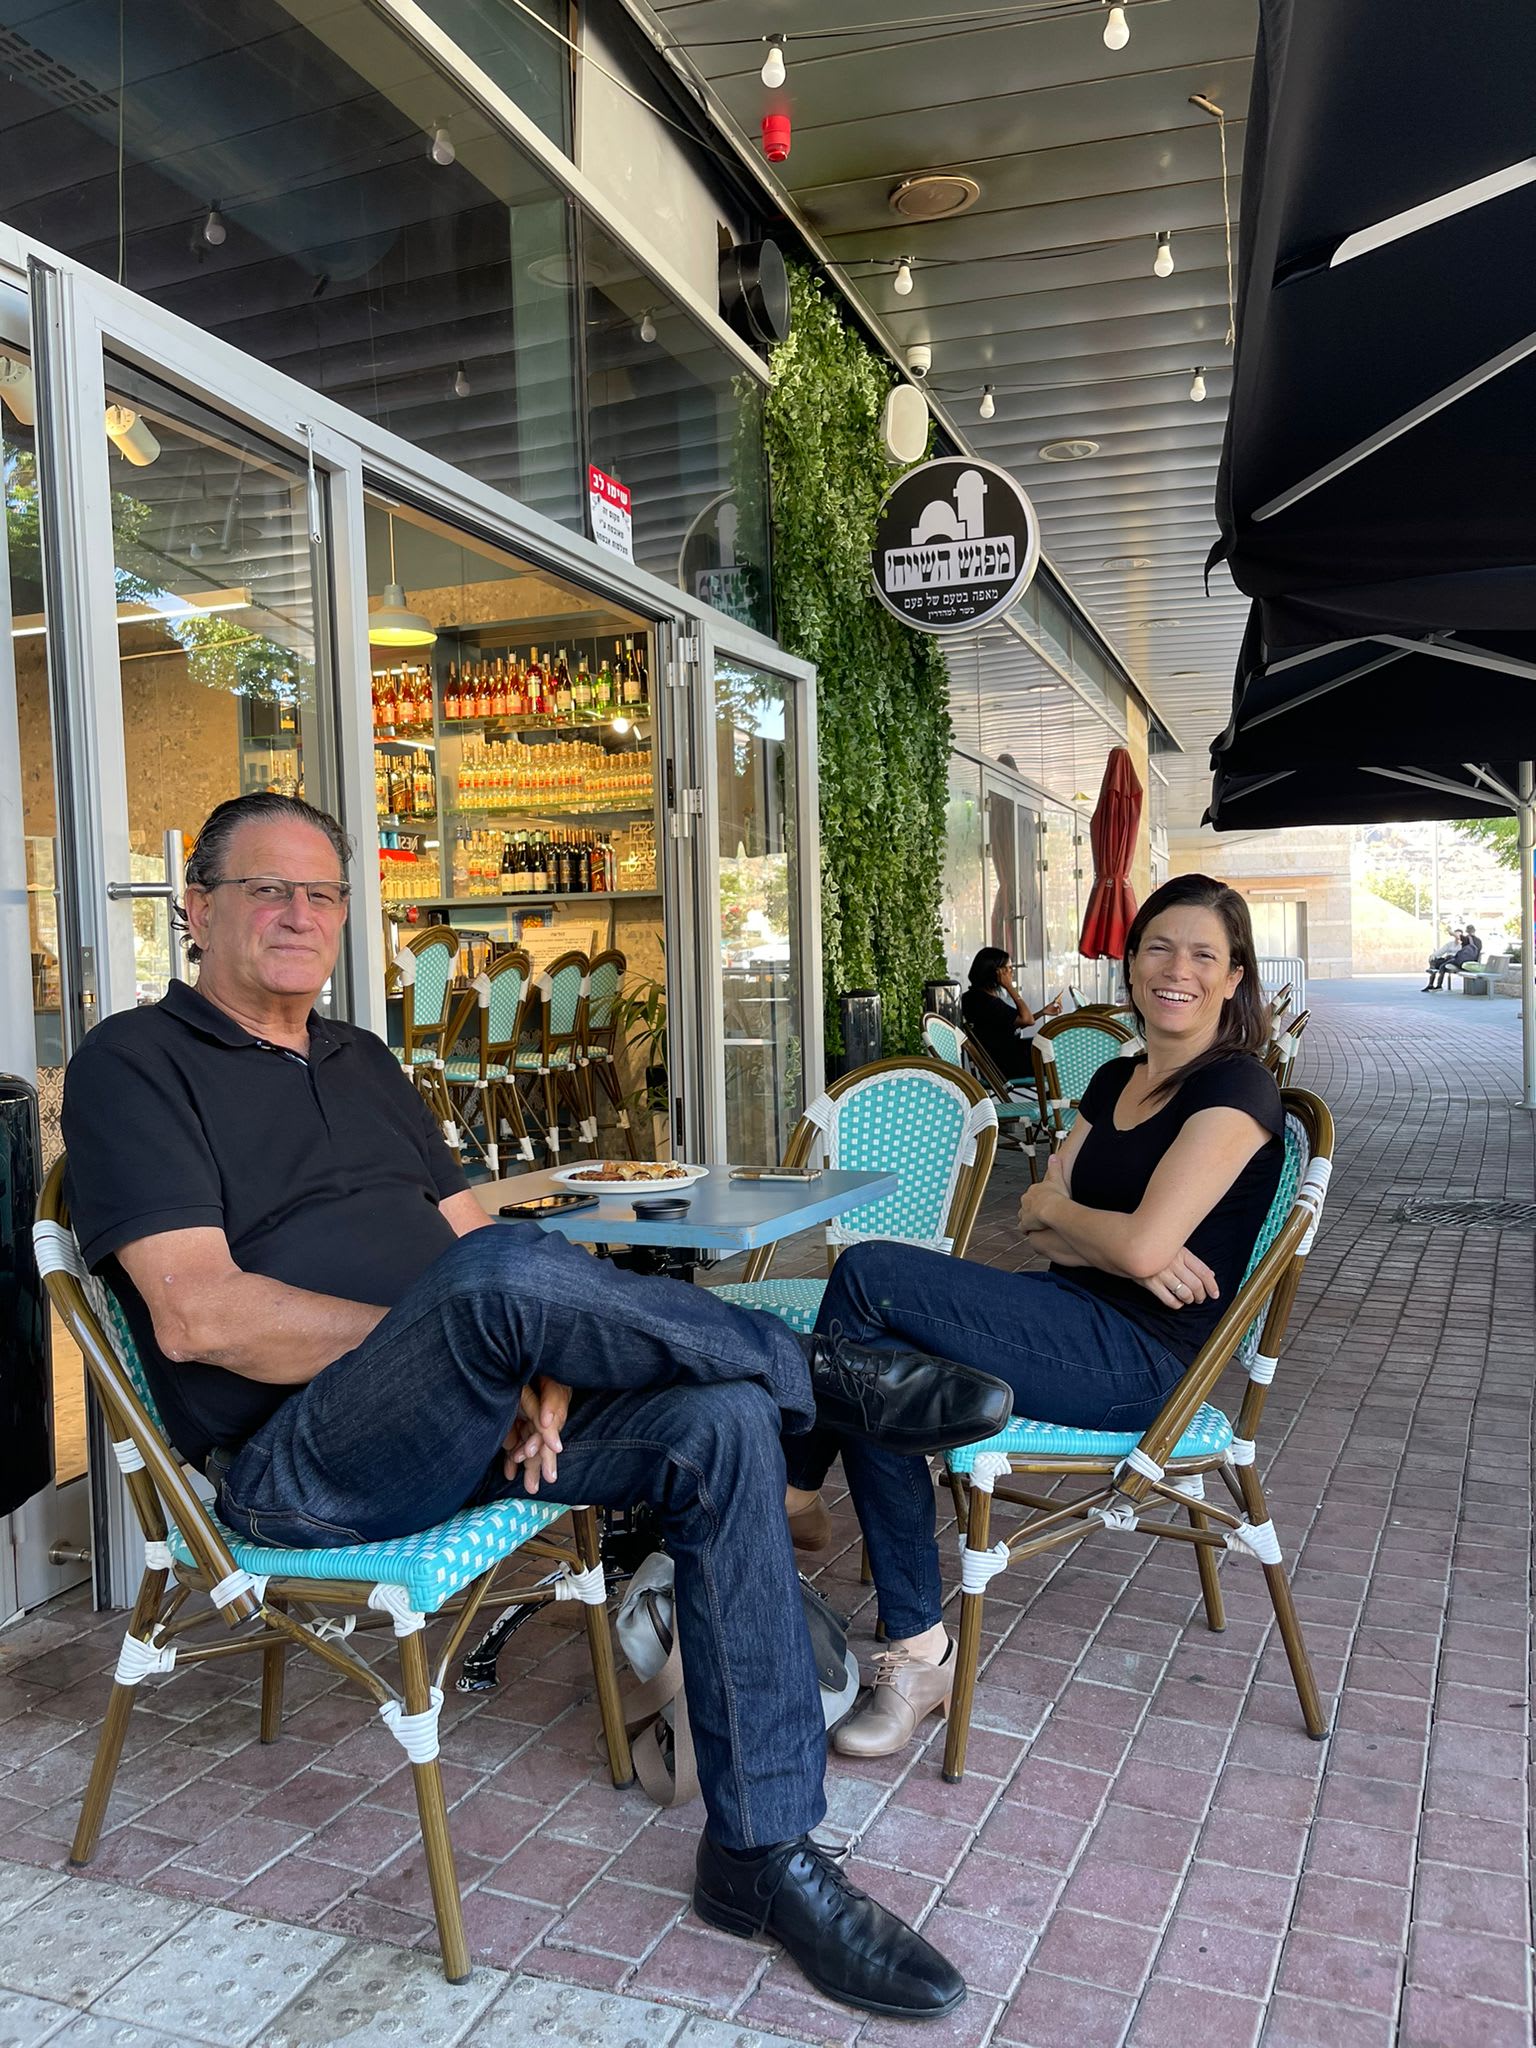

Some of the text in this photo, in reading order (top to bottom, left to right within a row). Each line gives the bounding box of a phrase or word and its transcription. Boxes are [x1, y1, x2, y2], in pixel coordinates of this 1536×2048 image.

[593, 473, 628, 505] שימו לב
[958, 542, 1010, 578] מפגש
[904, 589, 998, 609] מאפה בטעם של פעם
[960, 607, 975, 615] כשר
